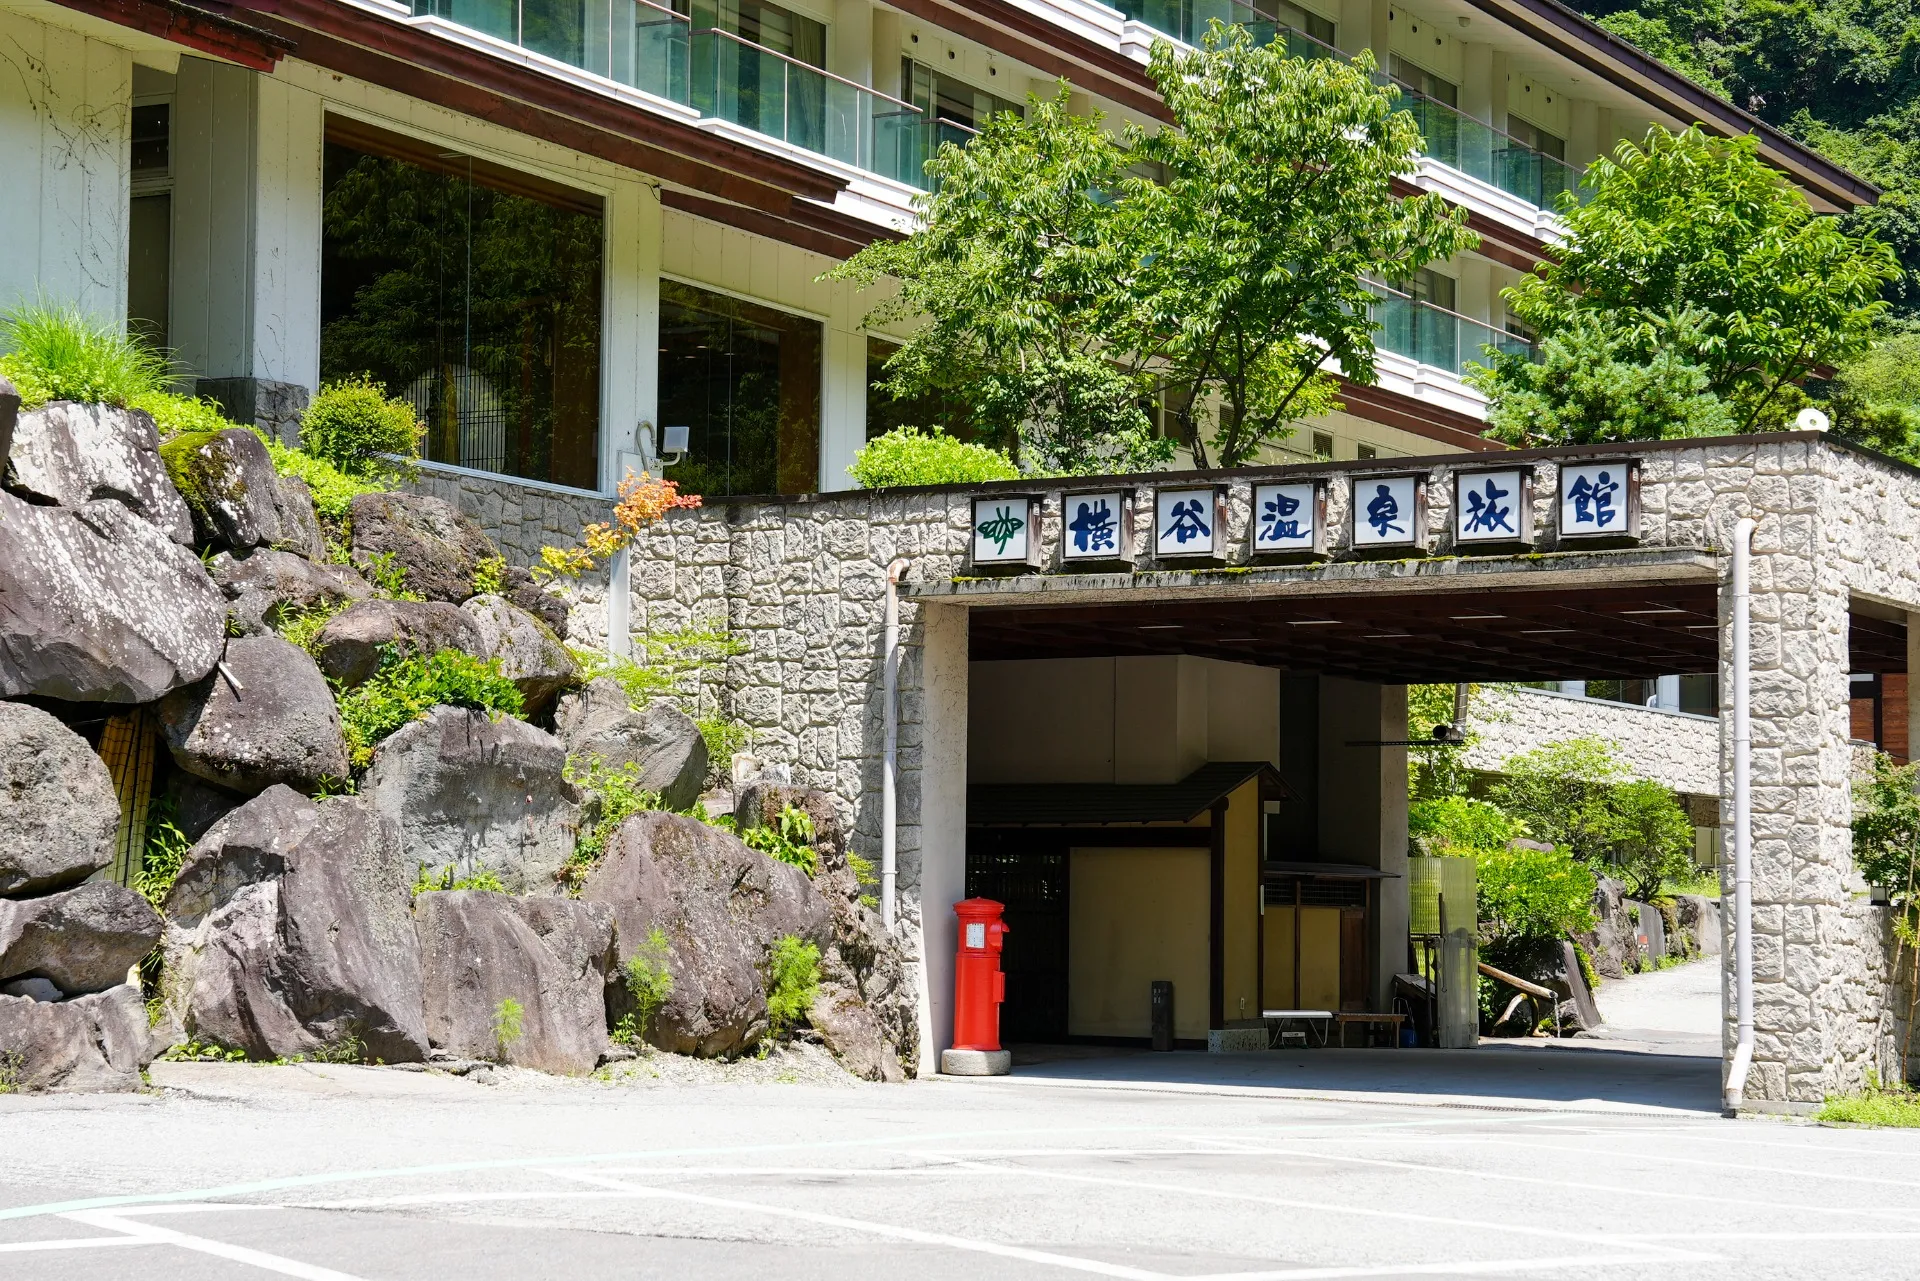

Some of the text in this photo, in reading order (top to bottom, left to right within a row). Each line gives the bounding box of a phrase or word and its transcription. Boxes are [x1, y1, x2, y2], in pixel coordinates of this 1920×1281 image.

[1069, 471, 1619, 553] 横谷温泉旅館
